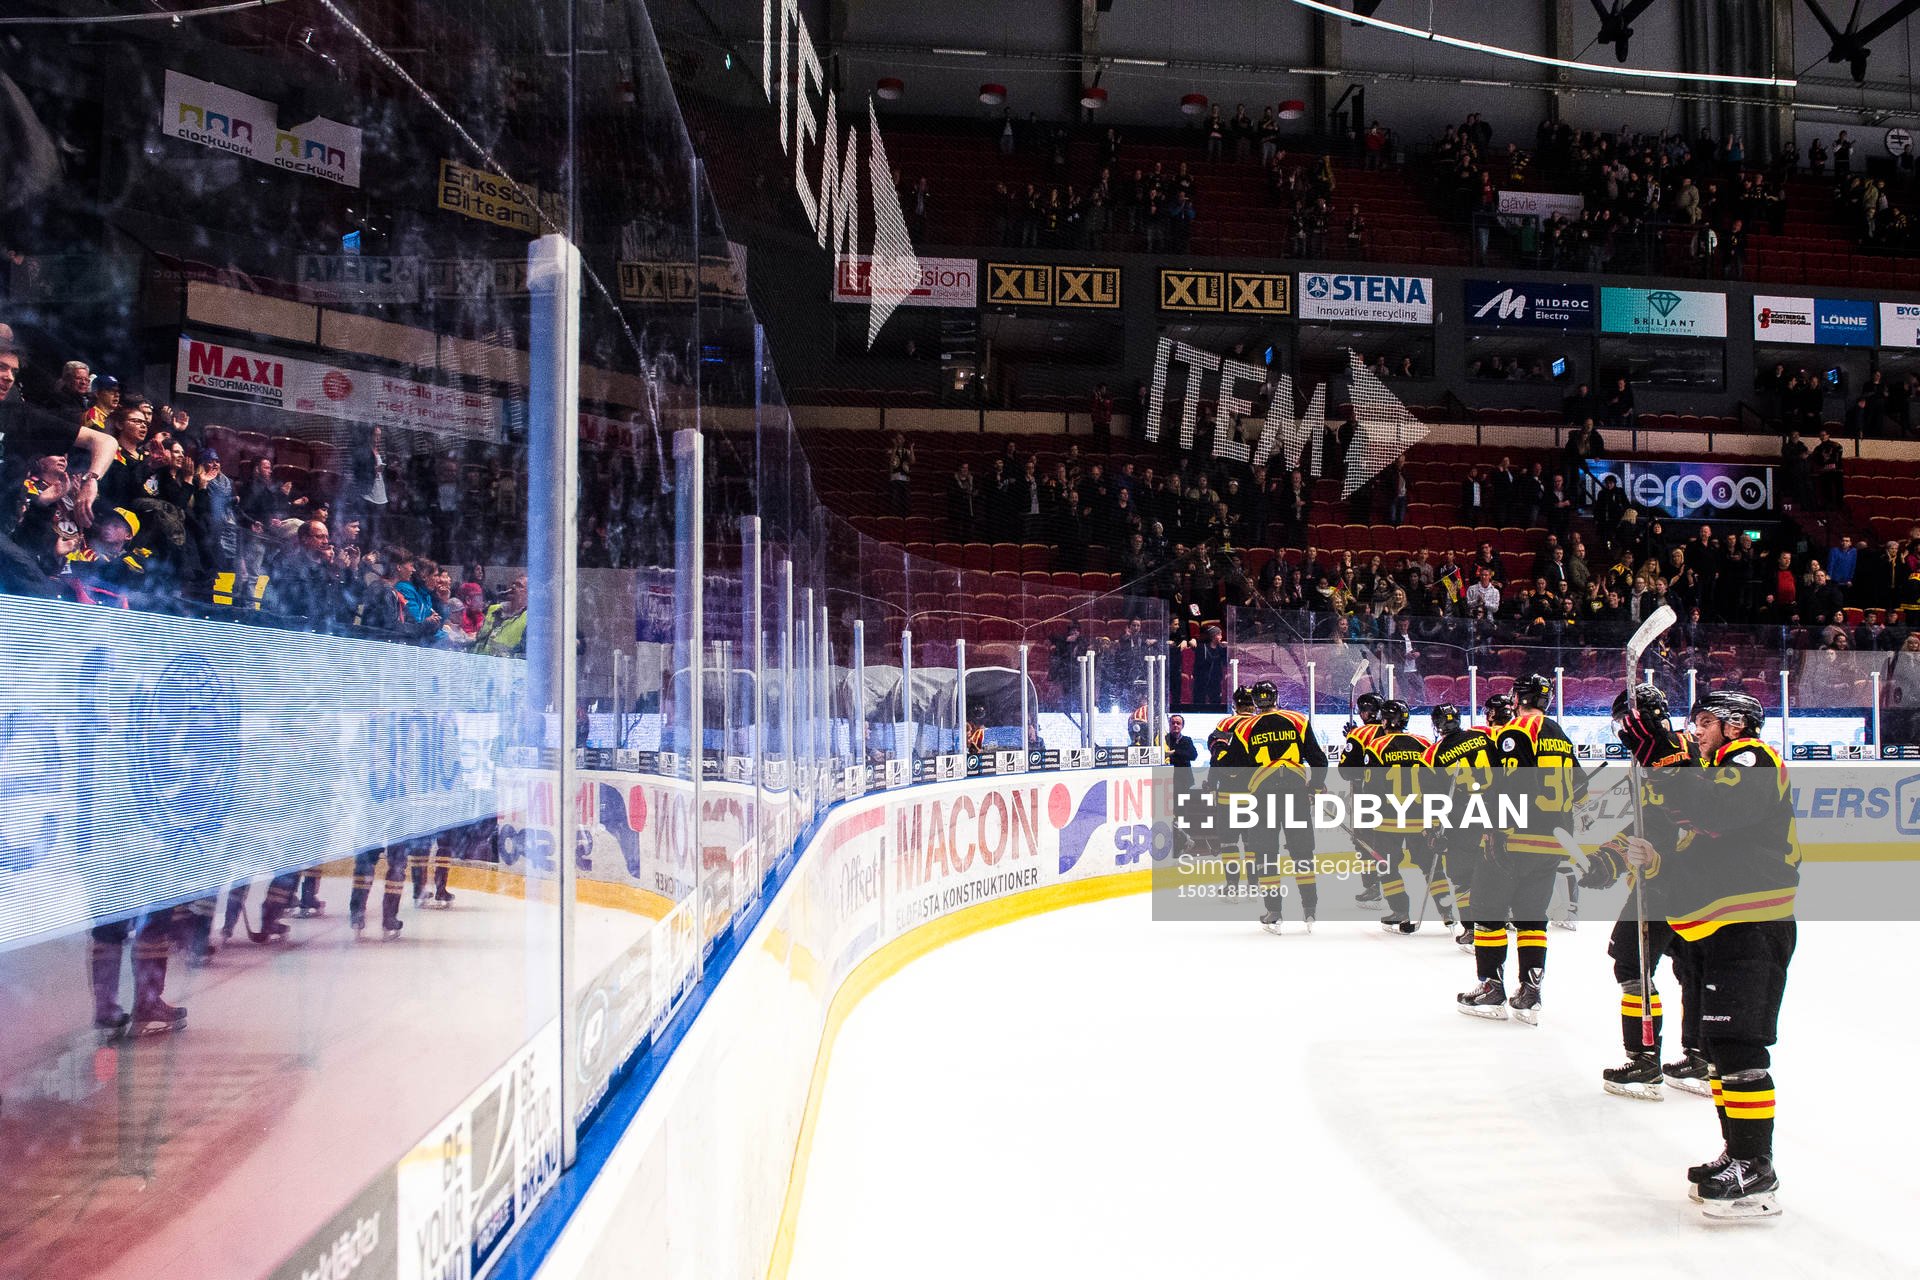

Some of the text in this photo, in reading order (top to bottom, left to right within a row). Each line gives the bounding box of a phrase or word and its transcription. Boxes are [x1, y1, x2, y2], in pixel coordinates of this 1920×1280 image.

[179, 128, 253, 156] clockwork
[274, 157, 344, 183] clockwork
[445, 165, 532, 207] Eriksso
[444, 187, 530, 226] Bilteam
[1501, 198, 1537, 212] gävle
[992, 268, 1045, 299] XL
[1060, 272, 1114, 301] XL
[1166, 276, 1218, 305] XL
[1233, 279, 1284, 308] XL
[1333, 275, 1427, 304] STENA
[1317, 306, 1417, 320] Innovative recycling
[1535, 299, 1589, 308] MIDROC
[1535, 311, 1569, 320] Electro
[1634, 318, 1695, 327] BRILJANT
[1821, 314, 1868, 326] LÖNNE
[189, 341, 283, 388] MAXI
[208, 378, 283, 398] STORMARKNAD
[1146, 337, 1327, 477] ITEM
[1251, 730, 1297, 746] WESTLUND
[1439, 736, 1487, 764] MANNBERG
[1115, 778, 1174, 822] INTE
[1792, 787, 1891, 819] LERS
[897, 788, 1038, 893] MACON
[1114, 821, 1173, 866] SPO
[943, 867, 1038, 910] KONSTRUKTIONER
